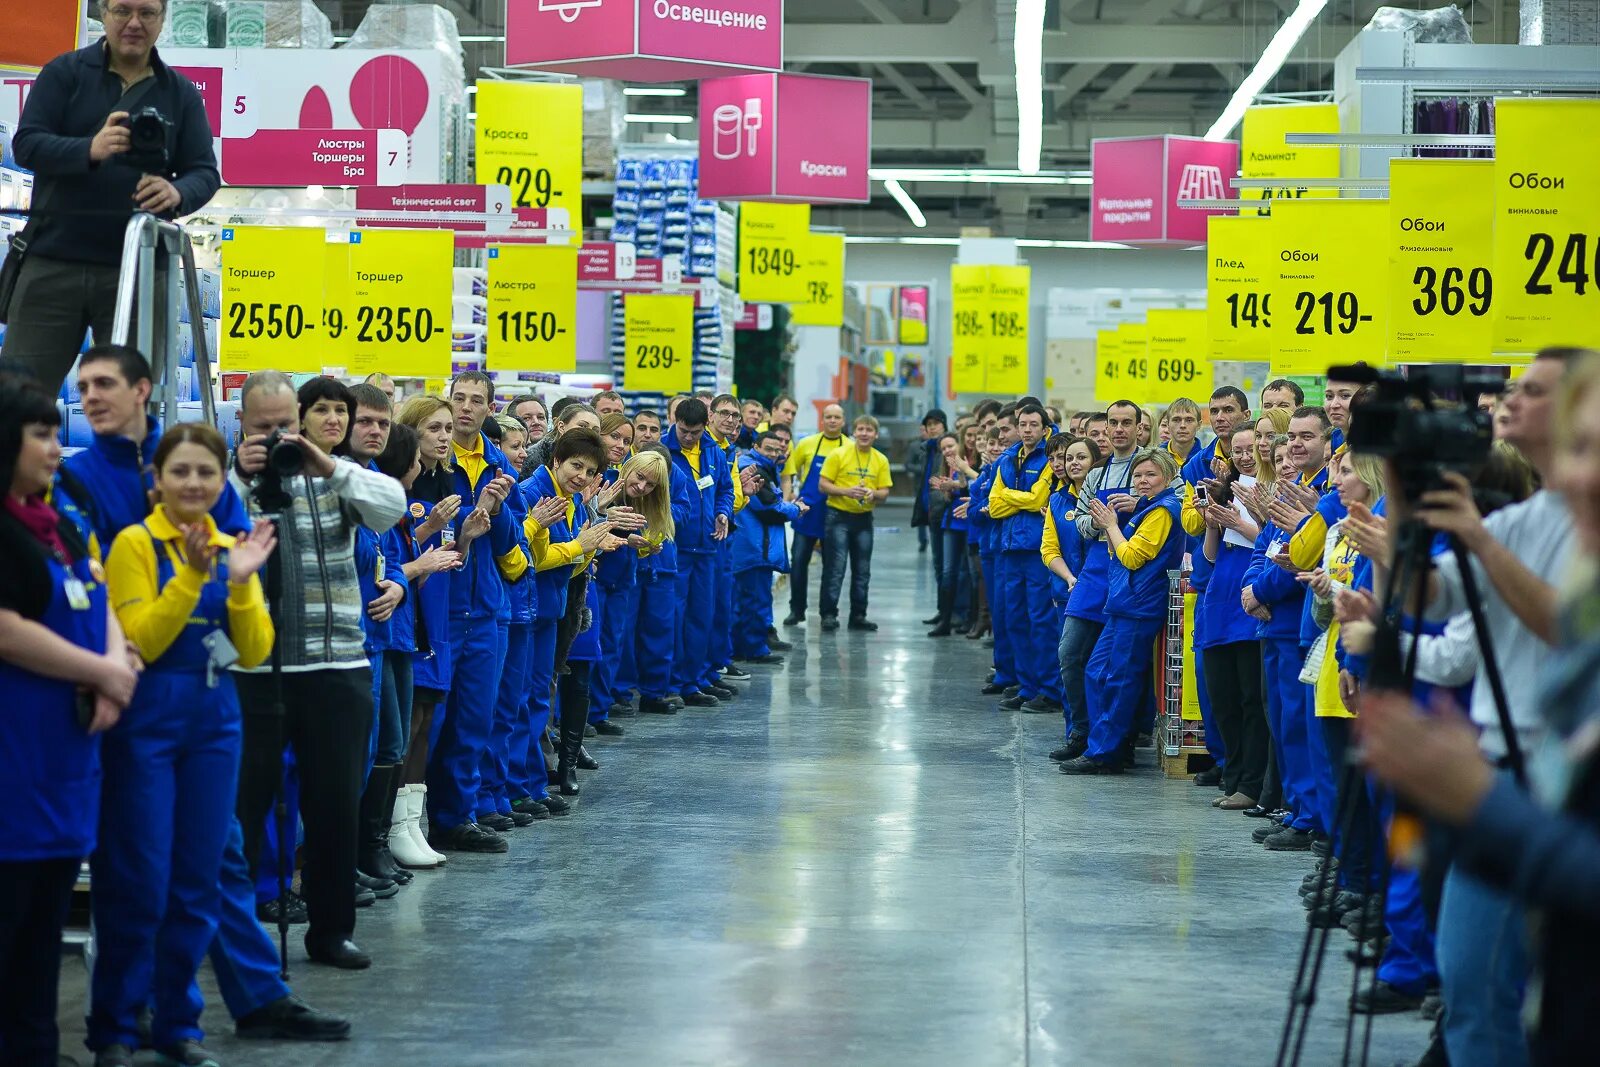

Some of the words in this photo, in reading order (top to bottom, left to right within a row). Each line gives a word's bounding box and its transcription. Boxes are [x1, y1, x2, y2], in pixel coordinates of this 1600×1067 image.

[654, 0, 767, 30] Освещение
[233, 96, 247, 114] 5
[484, 127, 528, 140] Краска
[318, 138, 365, 150] Люстры
[312, 152, 365, 164] Торшеры
[388, 151, 398, 166] 7
[1250, 152, 1297, 161] Ламинат
[343, 166, 365, 178] Бра
[800, 160, 848, 178] Краски
[1509, 172, 1564, 189] Обои
[391, 196, 452, 207] Технический
[453, 198, 477, 207] свет
[495, 202, 504, 213] 9
[1400, 217, 1445, 231] Обои
[619, 256, 632, 266] 13
[748, 247, 801, 276] 1349-
[1280, 250, 1319, 261] Обои
[1216, 258, 1245, 269] Плед
[228, 267, 276, 279] Торшер
[356, 271, 404, 283] Торшер
[494, 281, 536, 291] Люстра
[1412, 266, 1493, 317] 369
[229, 302, 315, 339] 2550-
[1295, 292, 1373, 335] 219-
[357, 306, 444, 343] 2350-
[497, 311, 566, 342] 1150-
[637, 345, 681, 369] 239-
[1158, 358, 1203, 382] 699-
